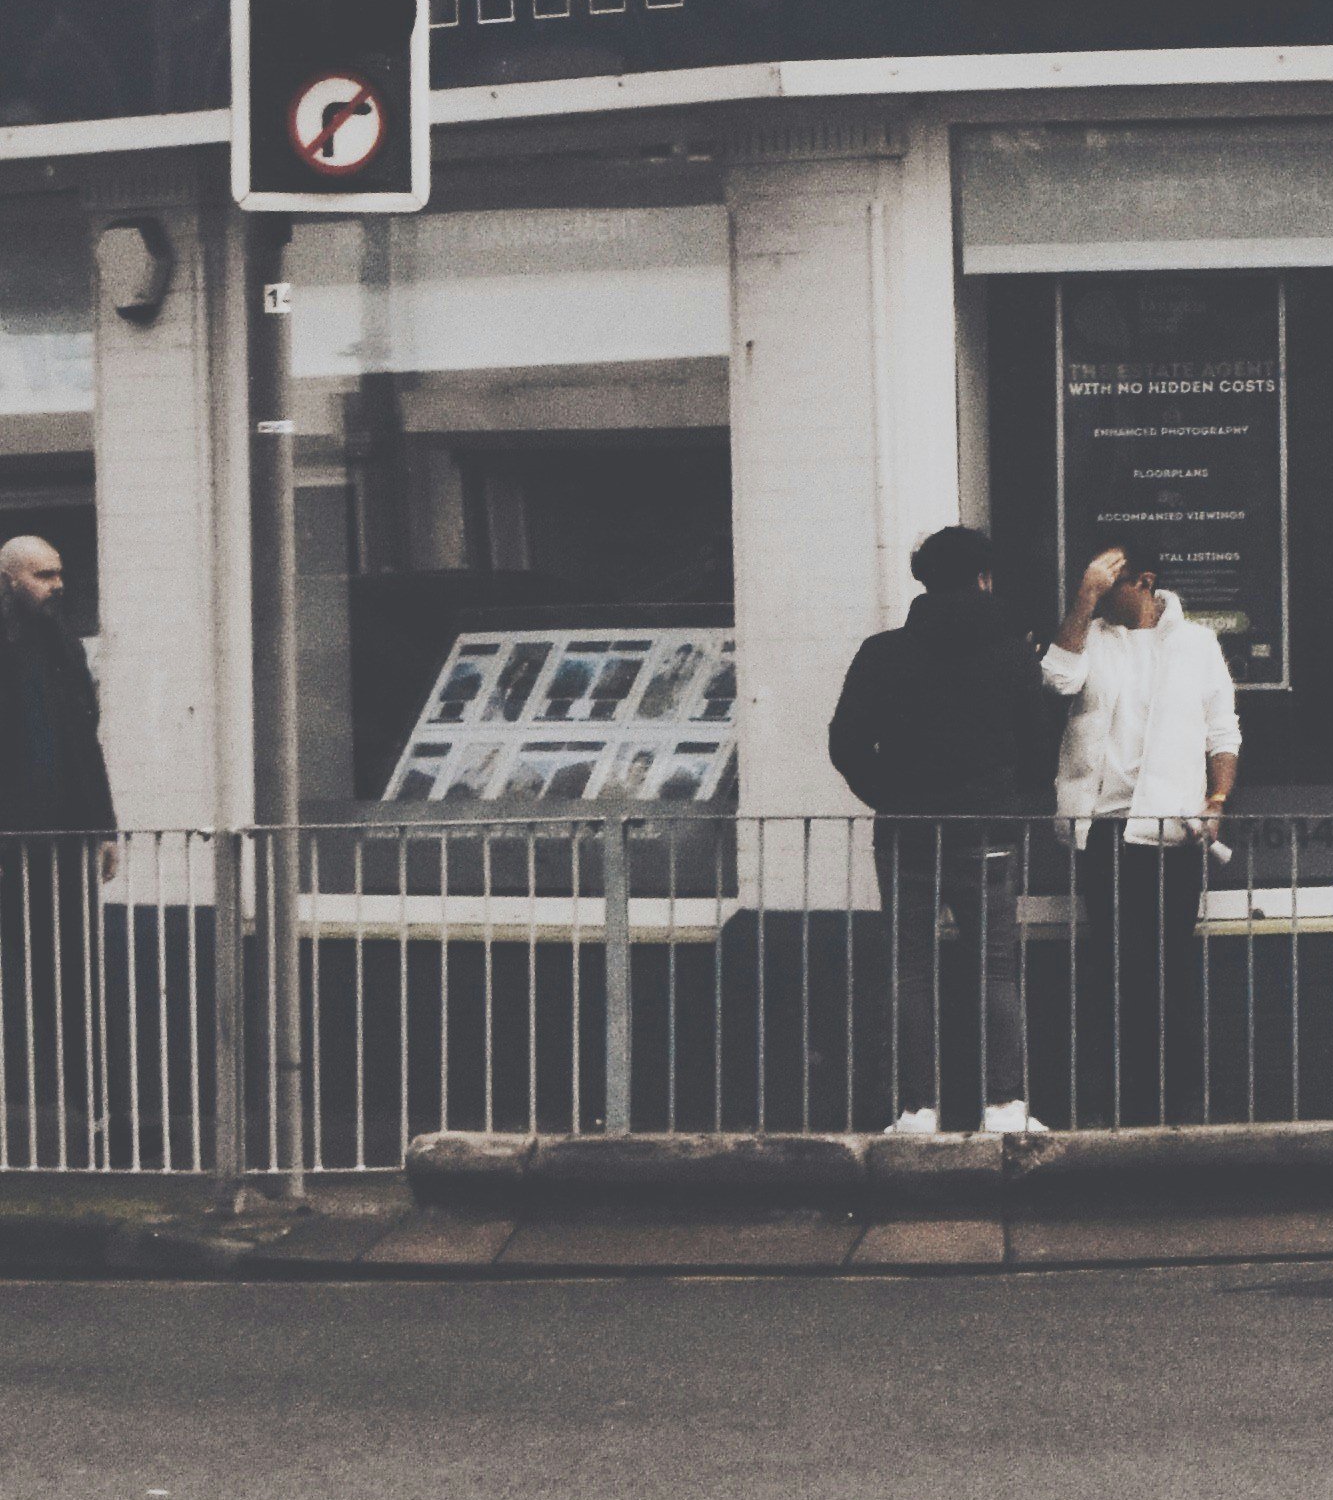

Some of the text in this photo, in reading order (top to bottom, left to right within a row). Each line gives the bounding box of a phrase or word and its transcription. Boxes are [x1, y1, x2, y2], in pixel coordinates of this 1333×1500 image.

[1068, 379, 1276, 396] WITH NO HIDDEN COSTS
[1094, 425, 1250, 438] ENHANCED PHOTOGRAPHY
[1133, 468, 1209, 479] FLOORPLANS
[1096, 510, 1246, 522] ACCOMPANIED VIEWINGS
[1187, 551, 1241, 562] LISTINGS
